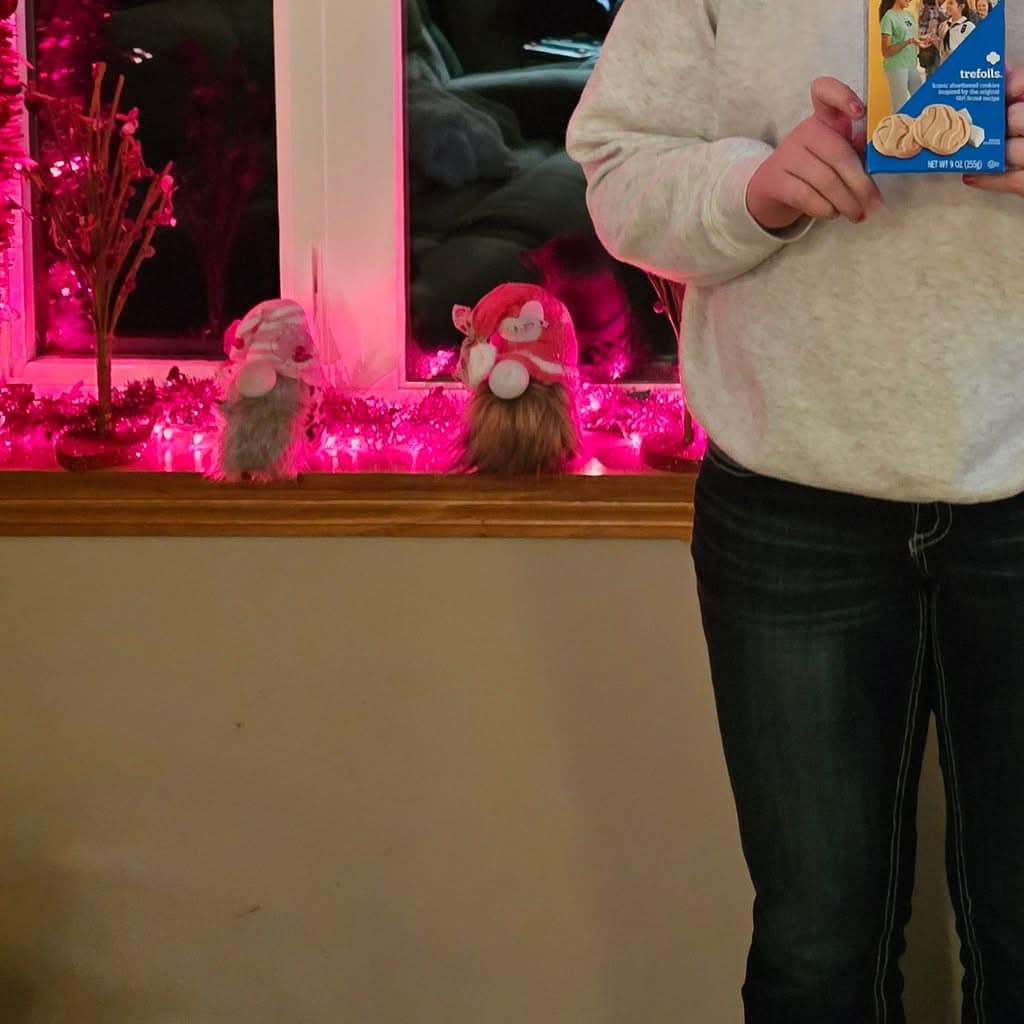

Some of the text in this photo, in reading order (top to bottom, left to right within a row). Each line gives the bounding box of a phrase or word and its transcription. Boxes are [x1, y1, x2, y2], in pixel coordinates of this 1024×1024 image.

[927, 160, 938, 169] NET
[939, 160, 948, 169] WT
[949, 160, 954, 169] 9
[955, 160, 963, 169] OZ
